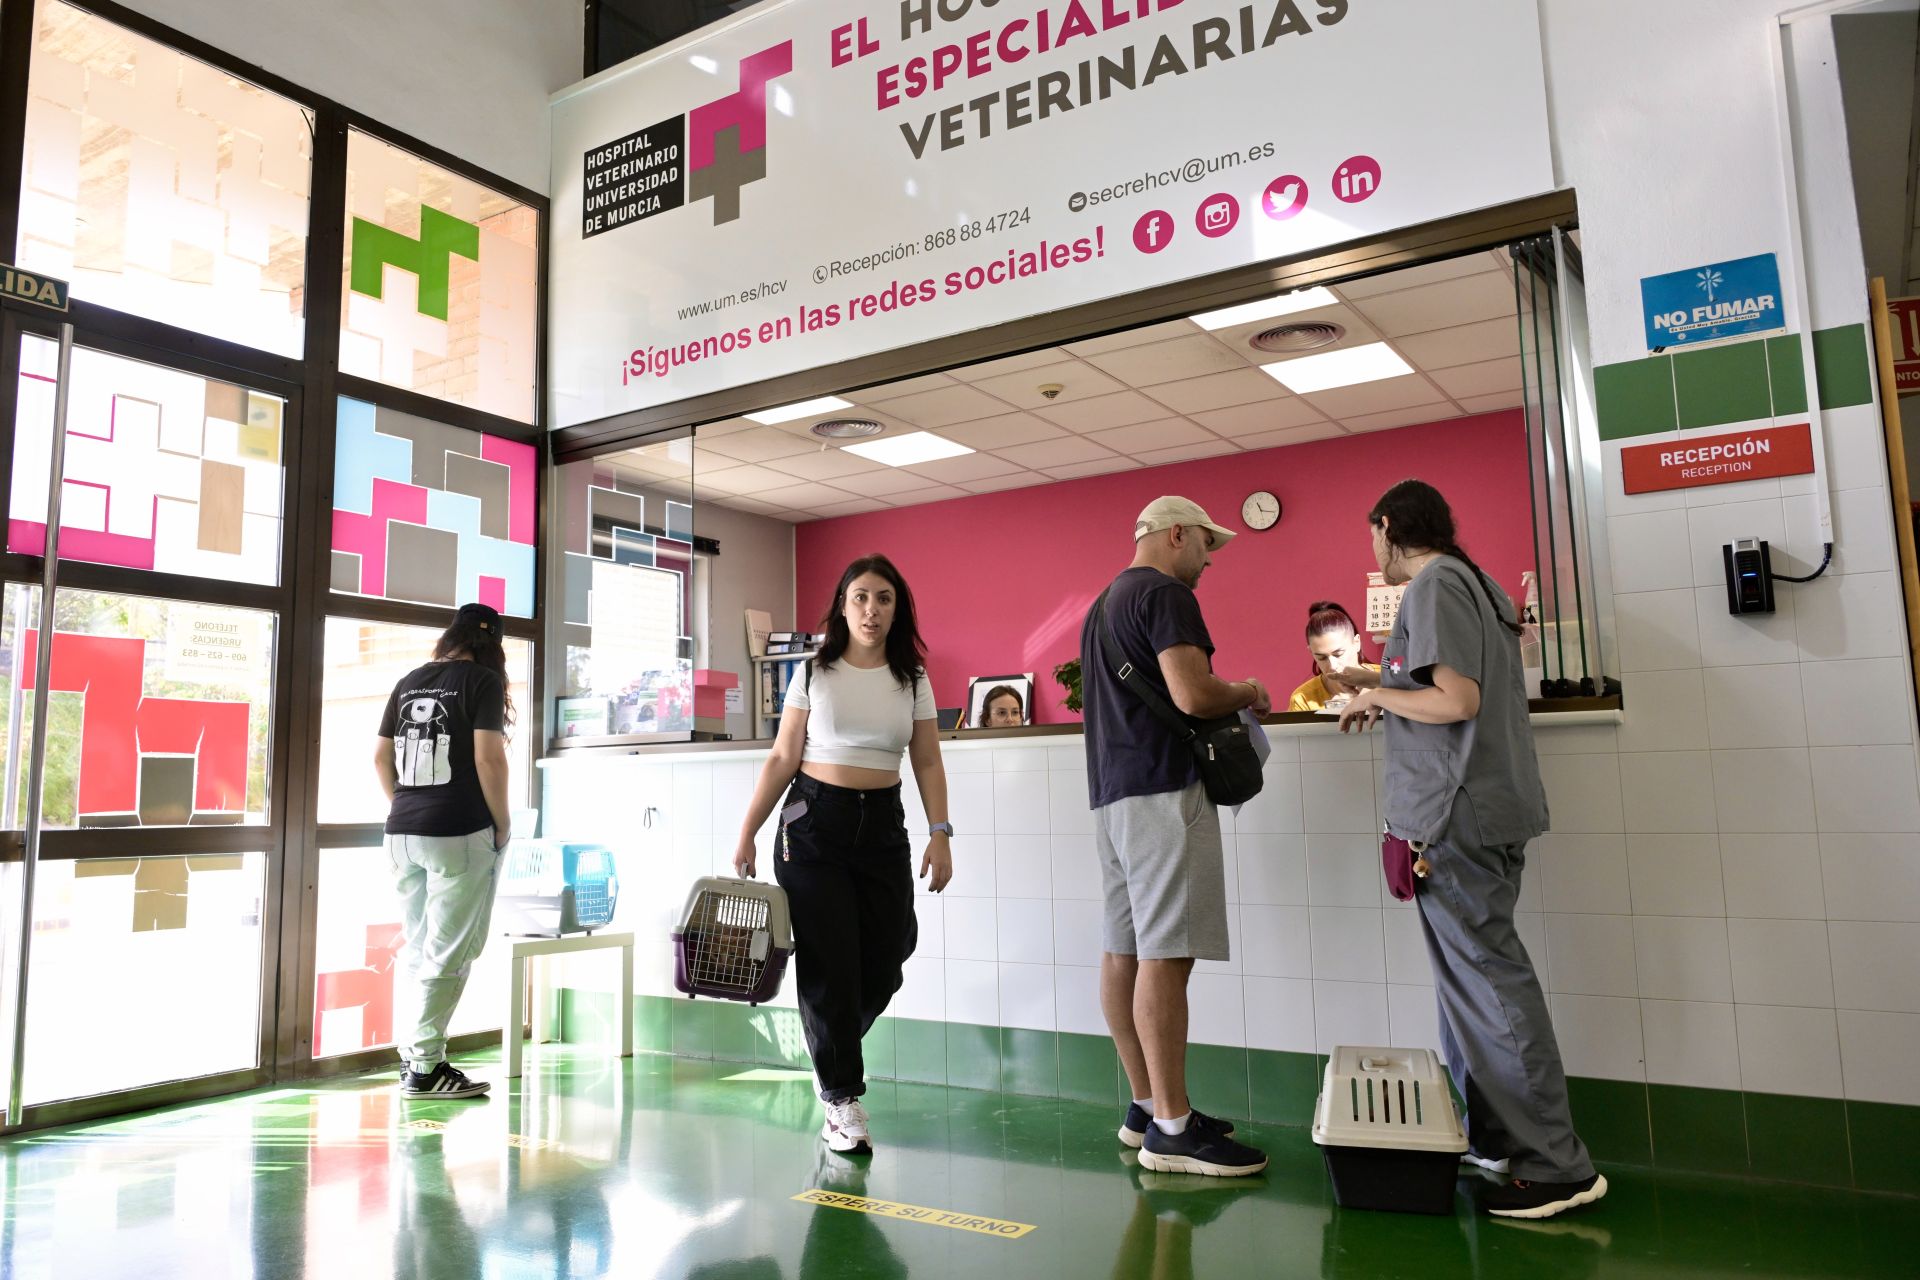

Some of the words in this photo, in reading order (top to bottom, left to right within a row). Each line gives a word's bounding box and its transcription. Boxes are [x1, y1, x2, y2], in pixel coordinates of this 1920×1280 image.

[831, 16, 880, 68] EL
[900, 0, 1000, 42] HO
[877, 0, 1185, 111] ESPECIAL
[900, 0, 1348, 160] VETERINARIAS
[586, 144, 678, 191] VETERINARIO
[587, 133, 652, 170] HOSPITAL
[1088, 141, 1276, 206] secrehcv@um.es
[586, 166, 678, 212] UNIVERSIDAD
[585, 214, 603, 234] DE
[607, 194, 661, 226] MURCIA
[830, 242, 920, 278] Recepción:
[924, 228, 956, 252] 868
[960, 221, 982, 242] 88
[985, 206, 1032, 234] 4724
[0, 270, 60, 305] IDA
[622, 327, 752, 386] ¡Síguenos
[758, 316, 792, 344] en
[800, 304, 842, 334] las
[849, 280, 937, 321] redes
[944, 225, 1104, 296] sociales!
[677, 279, 788, 321] www.um.es/hcv
[1653, 310, 1688, 330] NO
[1692, 294, 1775, 322] FUMAR
[1660, 436, 1771, 467] RECEPCIÓN
[1681, 461, 1752, 479] RECEPTION
[804, 1192, 896, 1213] ESPERE
[896, 1207, 932, 1218] SU
[936, 1213, 1021, 1234] TURNO
